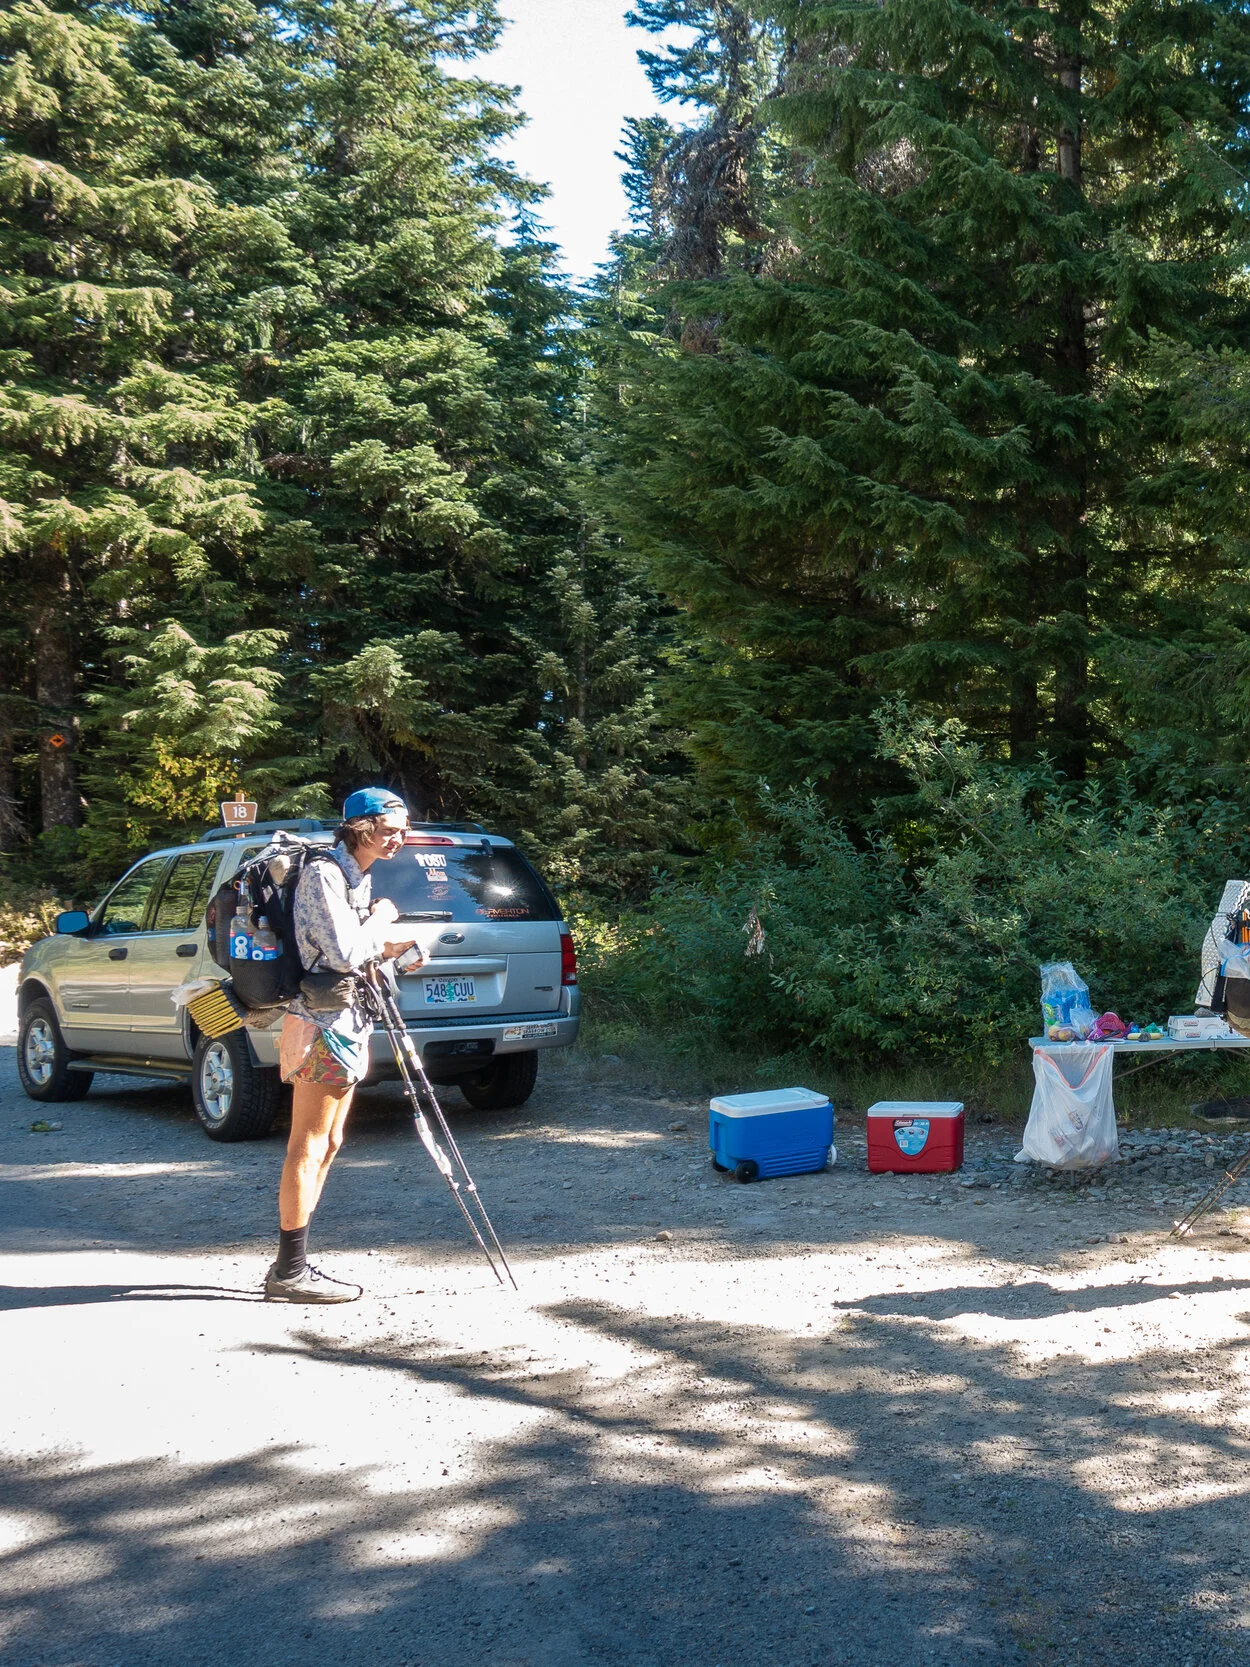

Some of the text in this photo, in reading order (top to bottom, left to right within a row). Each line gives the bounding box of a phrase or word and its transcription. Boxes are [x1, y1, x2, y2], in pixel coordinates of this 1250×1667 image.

[233, 806, 247, 818] 18
[426, 982, 474, 998] 548 CUU
